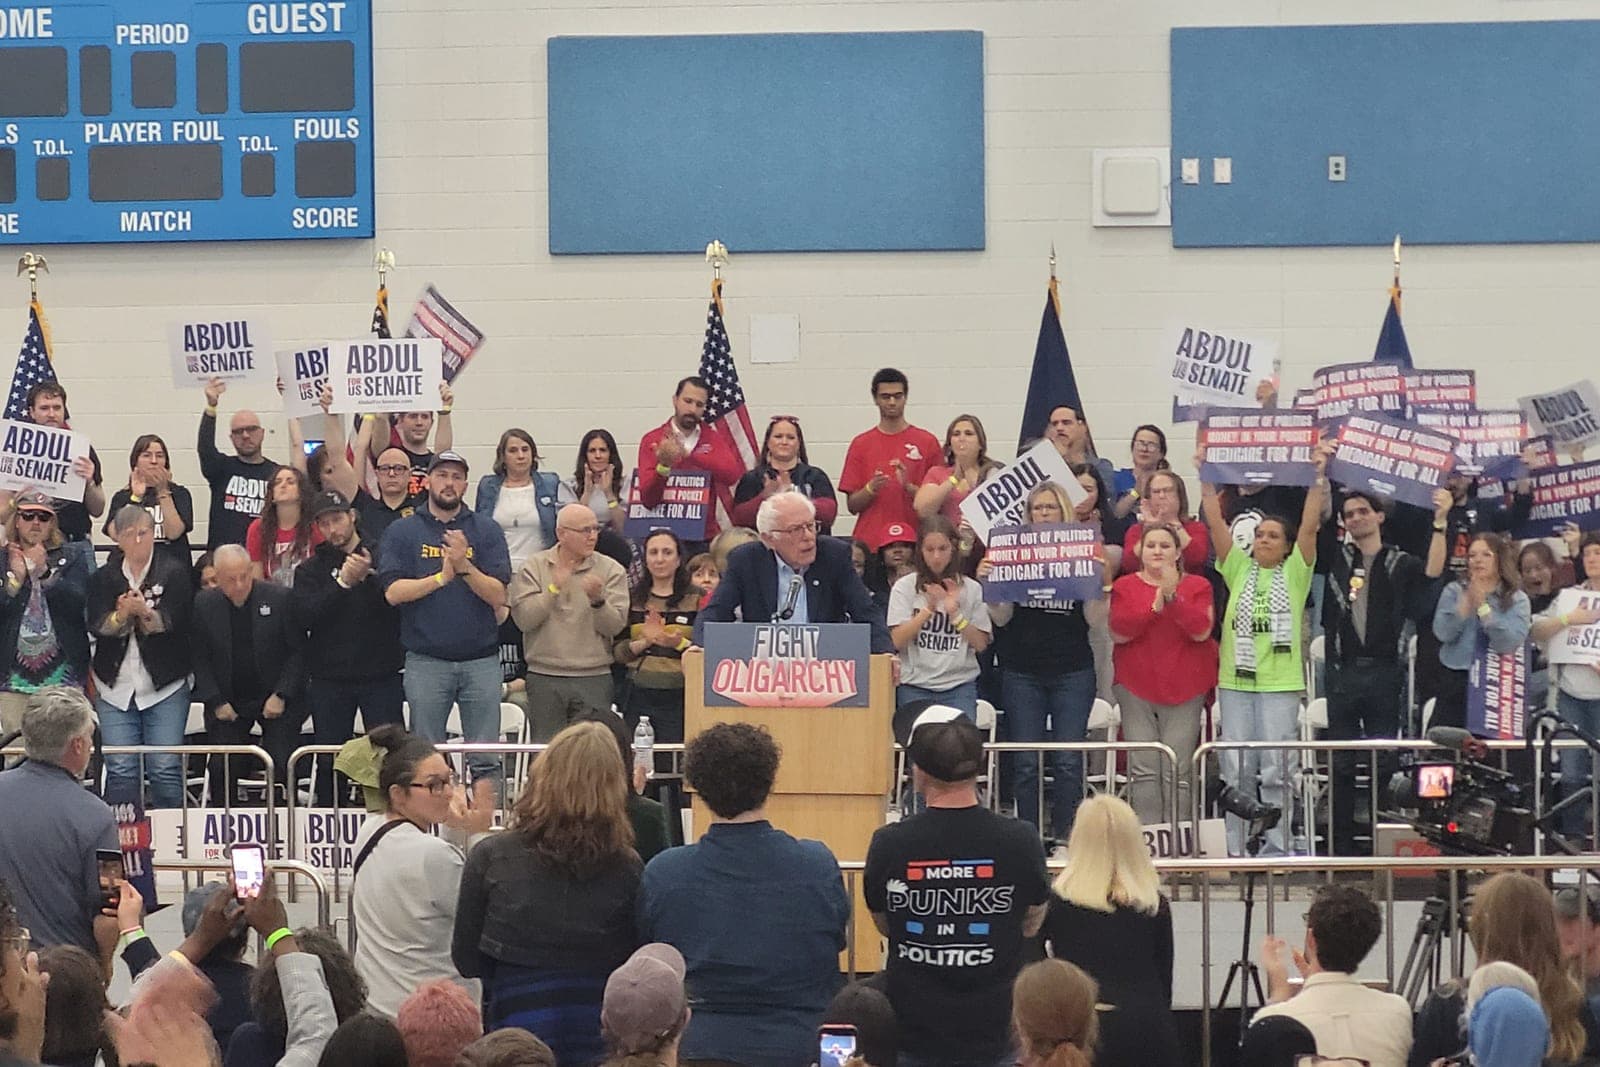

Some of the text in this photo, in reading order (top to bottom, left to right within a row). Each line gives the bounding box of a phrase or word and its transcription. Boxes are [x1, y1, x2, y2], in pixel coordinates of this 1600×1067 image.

[248, 2, 346, 34] GUEST
[116, 24, 189, 45] PERIOD
[85, 121, 224, 143] PLAYER FOUL
[294, 118, 360, 139] FOULS
[32, 139, 74, 155] T.O.L.
[239, 136, 278, 152] T.O.L.
[120, 211, 191, 232] MATCH
[292, 208, 358, 228] SCORE
[184, 320, 254, 352] ABDUL
[346, 344, 423, 374] ABDUL
[1176, 327, 1252, 373] ABDUL
[200, 350, 256, 373] SENATE
[347, 375, 423, 396] US SENATE
[1188, 362, 1249, 395] SENATE
[3, 425, 72, 463] ABDUL
[15, 457, 70, 484] SENATE
[1418, 465, 1440, 486] ALL
[977, 456, 1052, 521] ABDUL
[667, 504, 684, 518] FOR
[686, 504, 702, 518] ALL
[1570, 497, 1592, 515] FOR
[990, 529, 1094, 548] MONEY OUT OF POLITICS
[988, 544, 1094, 562] MONEY IN YOUR POCKET
[988, 560, 1095, 582] MEDICARE FOR ALL
[753, 625, 819, 658] FIGHT
[919, 632, 960, 651] SENATE
[712, 658, 857, 694] OLIGARCHY
[1485, 685, 1499, 708] FOR
[1484, 709, 1499, 730] ALL
[204, 814, 284, 845] ABDUL
[304, 813, 366, 845] BDU
[205, 848, 219, 859] FOR
[926, 867, 974, 879] MORE
[886, 885, 1015, 915] PUNKS
[937, 923, 955, 936] IN
[898, 943, 994, 966] POLITICS
